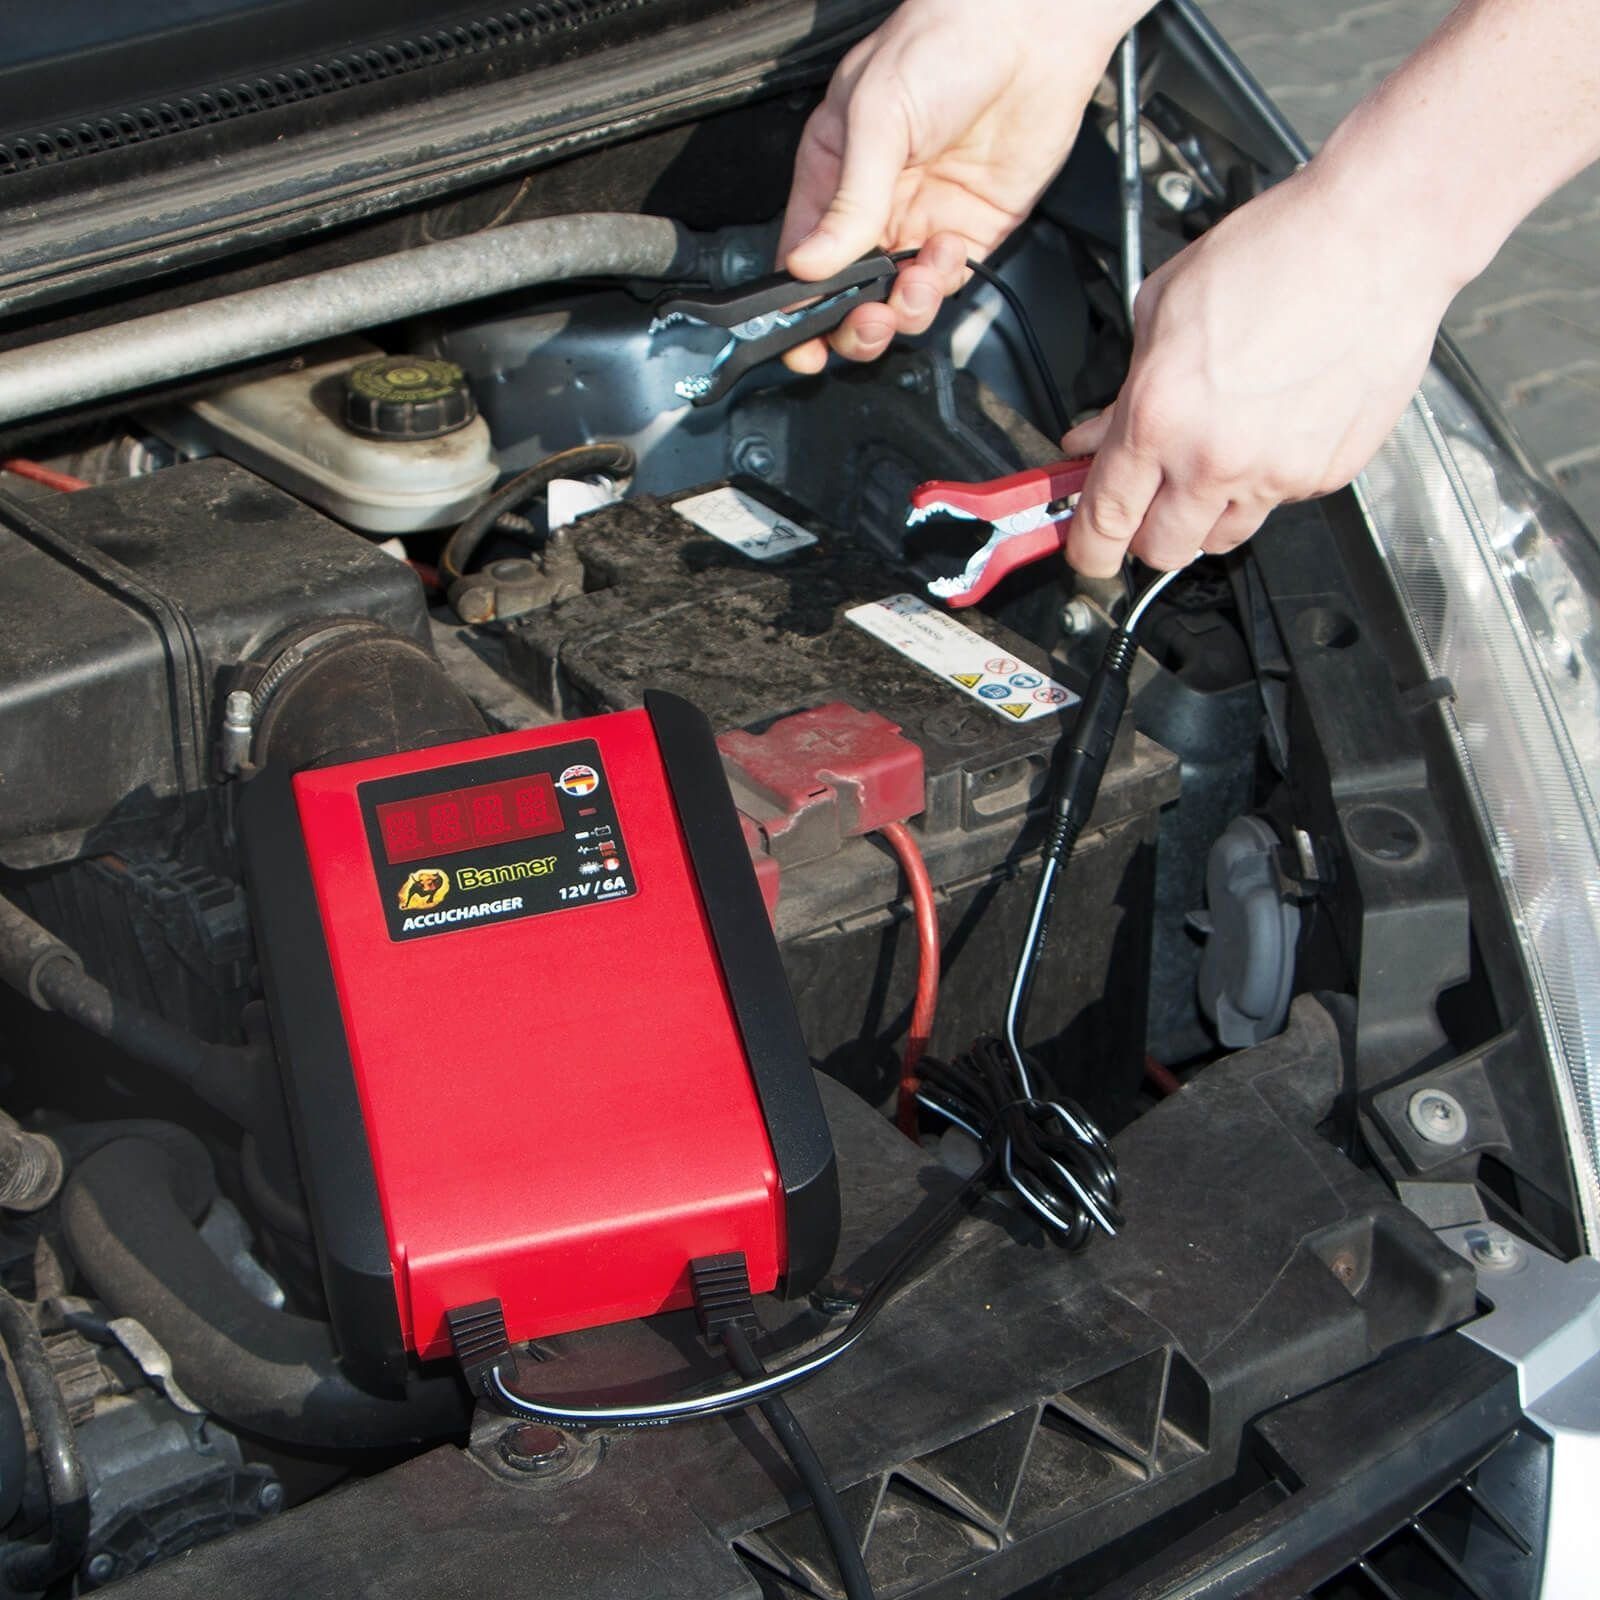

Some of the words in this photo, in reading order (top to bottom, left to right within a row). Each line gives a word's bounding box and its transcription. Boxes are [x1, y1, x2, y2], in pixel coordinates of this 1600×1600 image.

[456, 856, 557, 891] Banner
[558, 882, 591, 900] 12V
[602, 876, 627, 891] 6A
[402, 897, 524, 931] ACCUCHARGER
